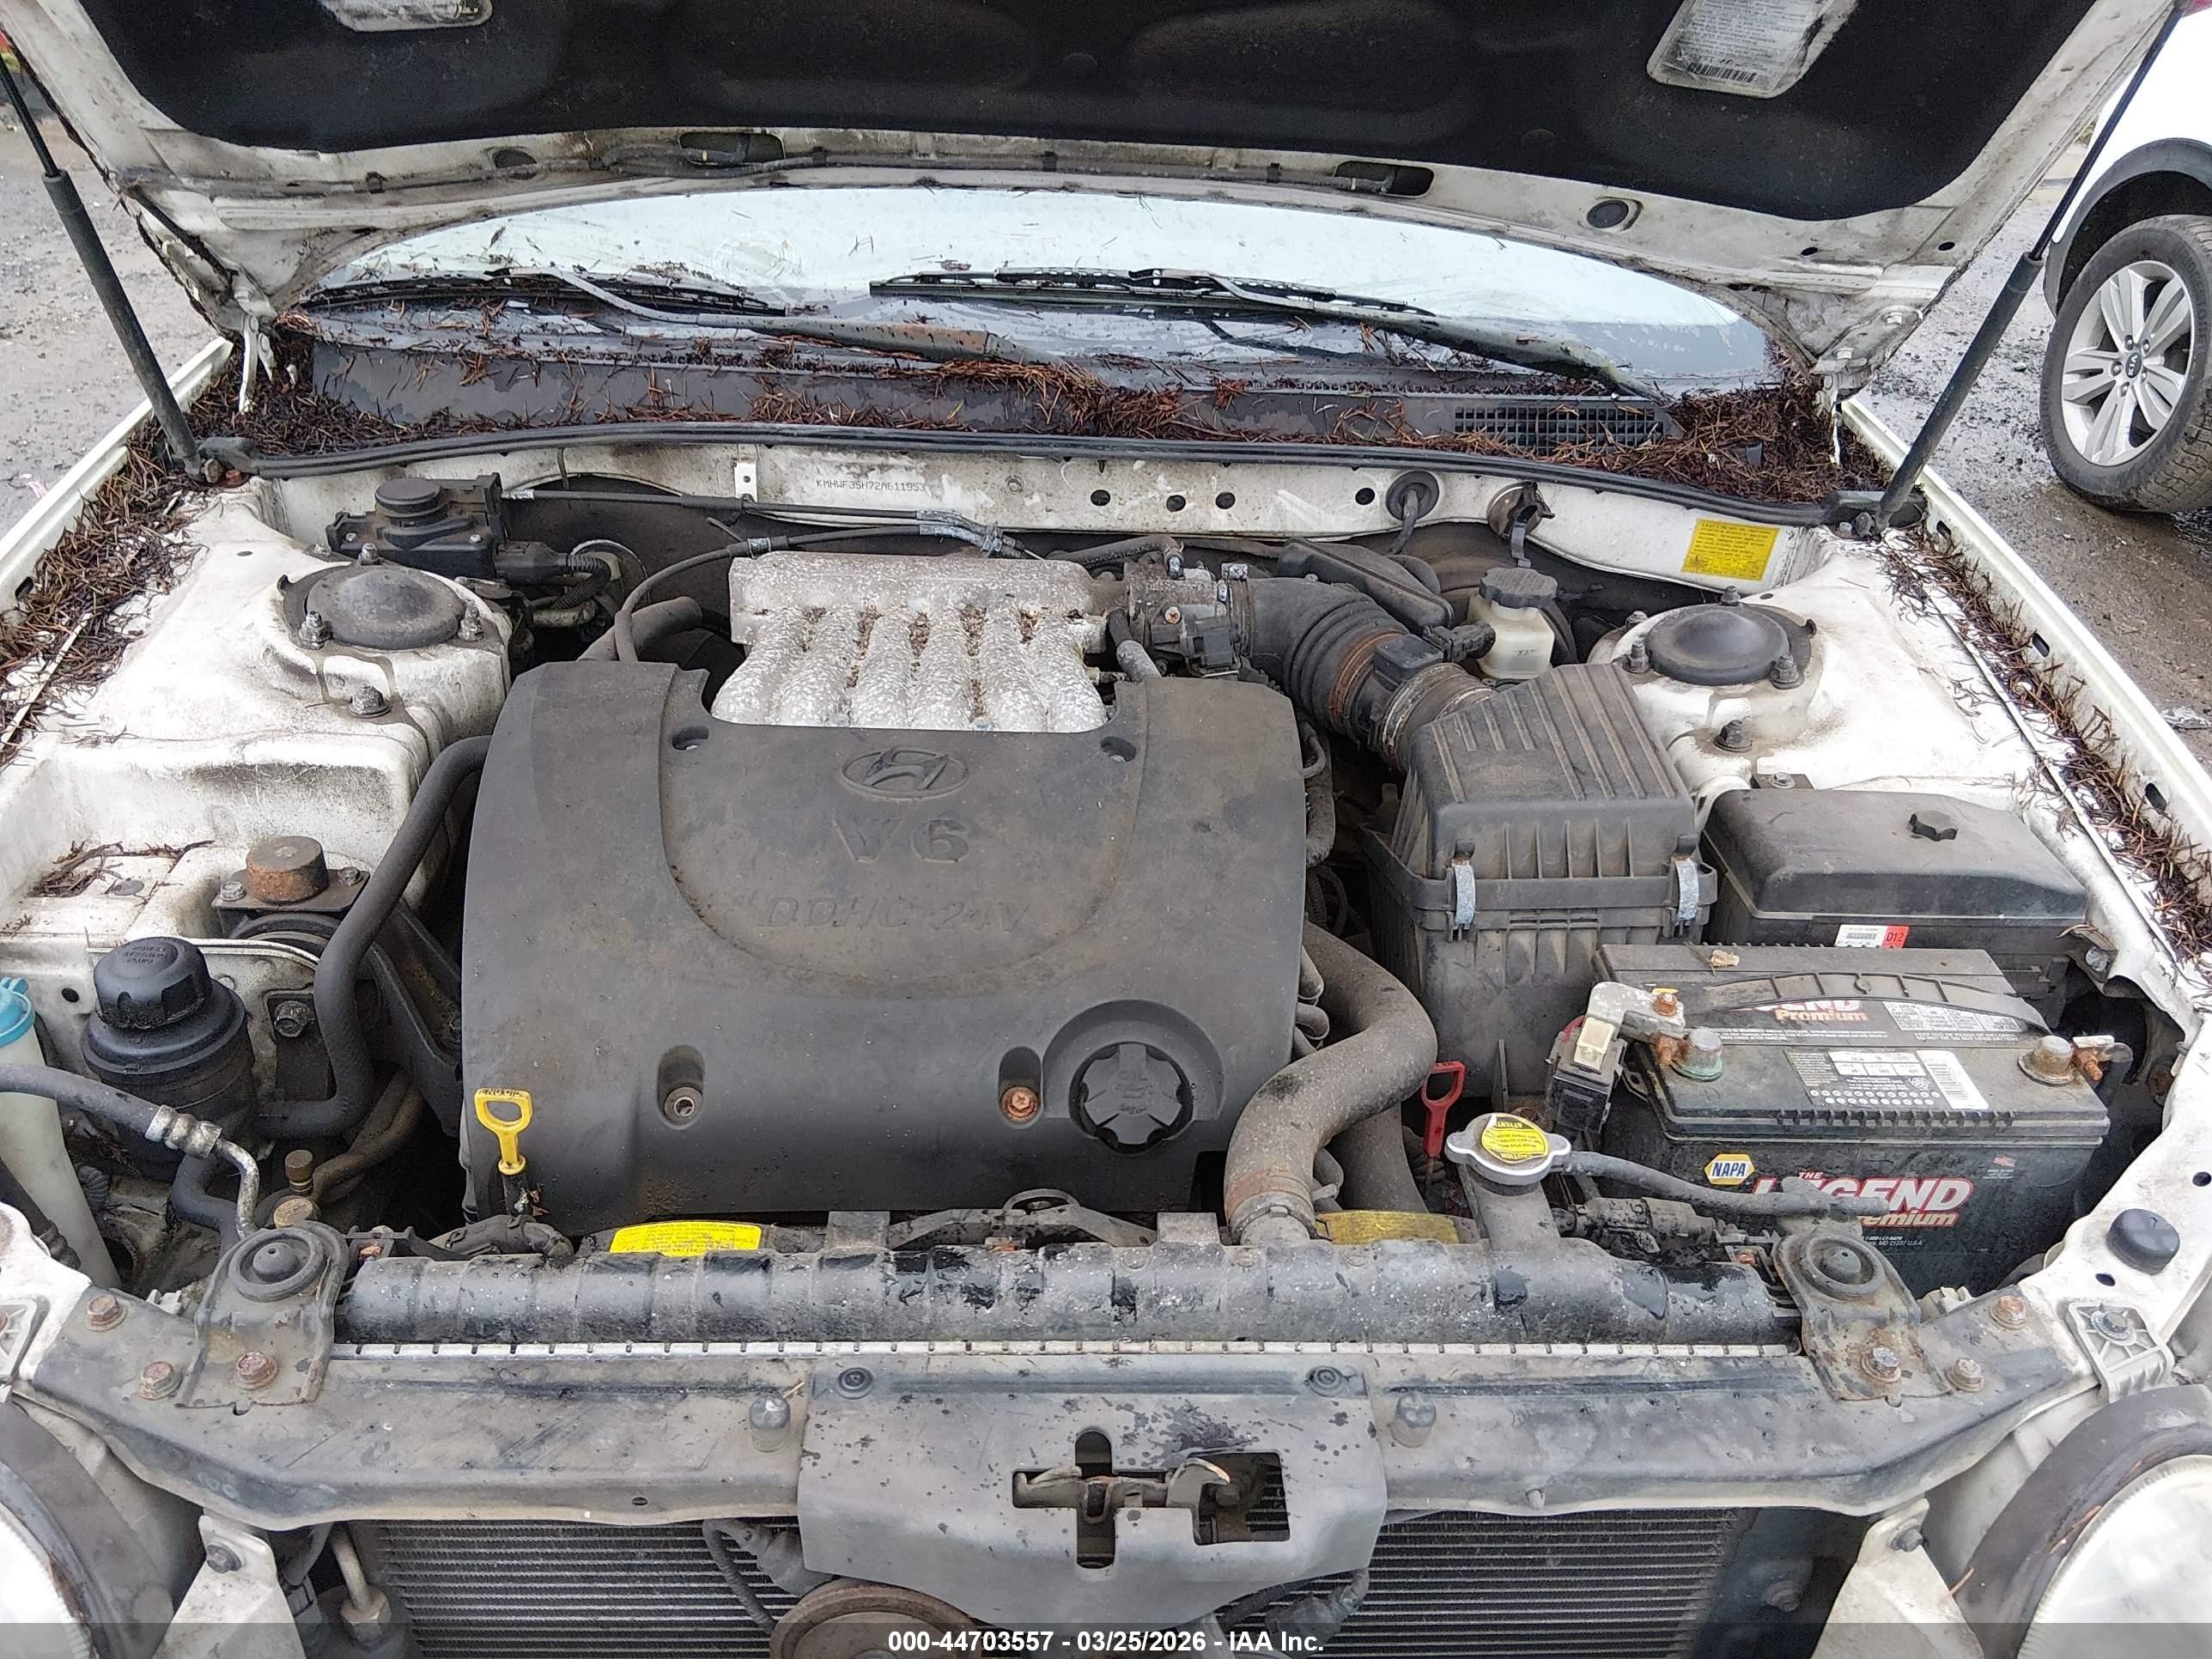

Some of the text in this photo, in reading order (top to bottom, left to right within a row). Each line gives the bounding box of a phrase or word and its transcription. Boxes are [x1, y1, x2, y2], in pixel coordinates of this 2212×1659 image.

[830, 817, 970, 863] V6
[1887, 932, 1905, 942] D12
[1711, 1162, 1747, 1178] NAPA
[1798, 1171, 1824, 1180] THE
[1754, 1177, 1972, 1212] GEND
[1856, 1212, 1955, 1227] remium
